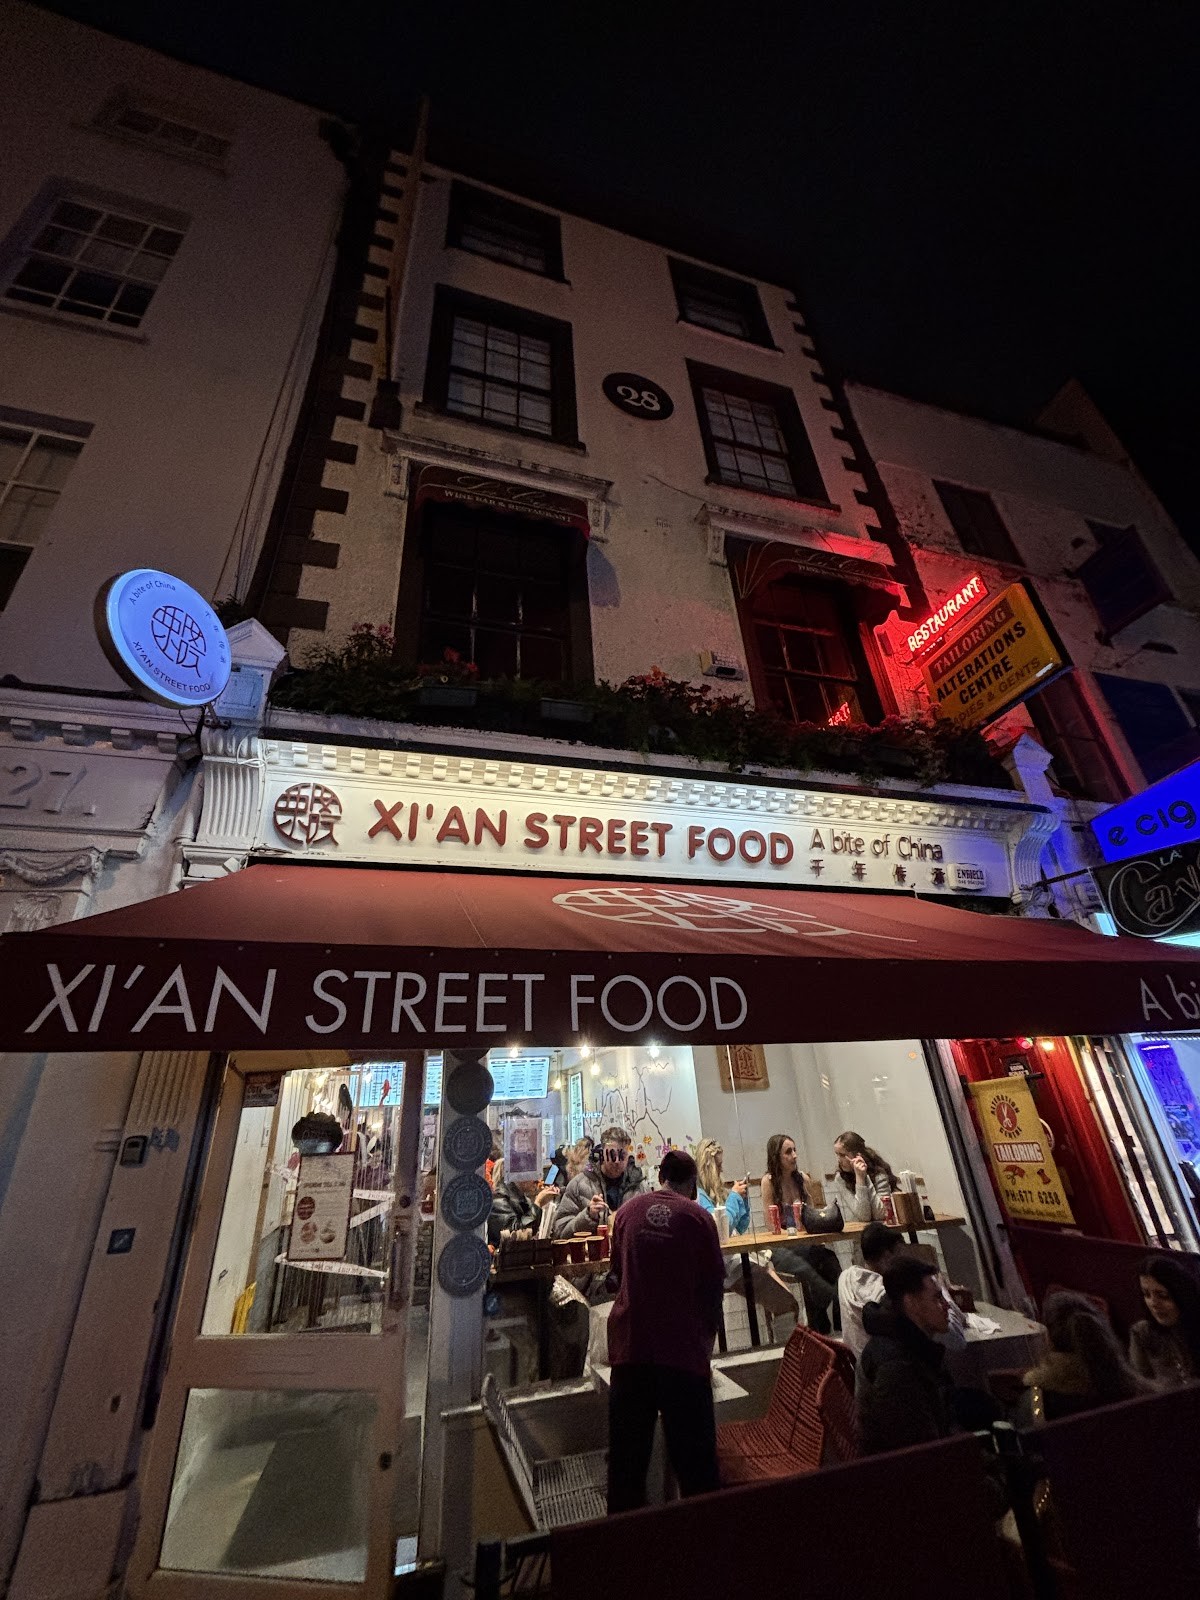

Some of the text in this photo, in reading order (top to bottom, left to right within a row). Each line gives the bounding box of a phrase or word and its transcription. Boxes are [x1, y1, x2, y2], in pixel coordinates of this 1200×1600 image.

[616, 385, 661, 411] 28
[133, 586, 145, 598] bite
[145, 581, 153, 590] of
[154, 580, 176, 591] China
[907, 576, 981, 651] RESTAURANT
[933, 608, 1007, 674] TAILORING
[936, 620, 1026, 703] ALTERATIONS
[132, 640, 211, 692] XI'AN STREET FOOD
[959, 655, 1014, 705] CENTRE
[999, 657, 1041, 693] GENTS
[367, 798, 795, 866] XI'AN STREET FOOD
[809, 828, 944, 861] A bite of China
[1108, 800, 1197, 846] e cig
[24, 963, 748, 1034] XI'AN STREET FOOD
[1140, 977, 1173, 1021] A
[994, 1143, 1044, 1162] TAILORING
